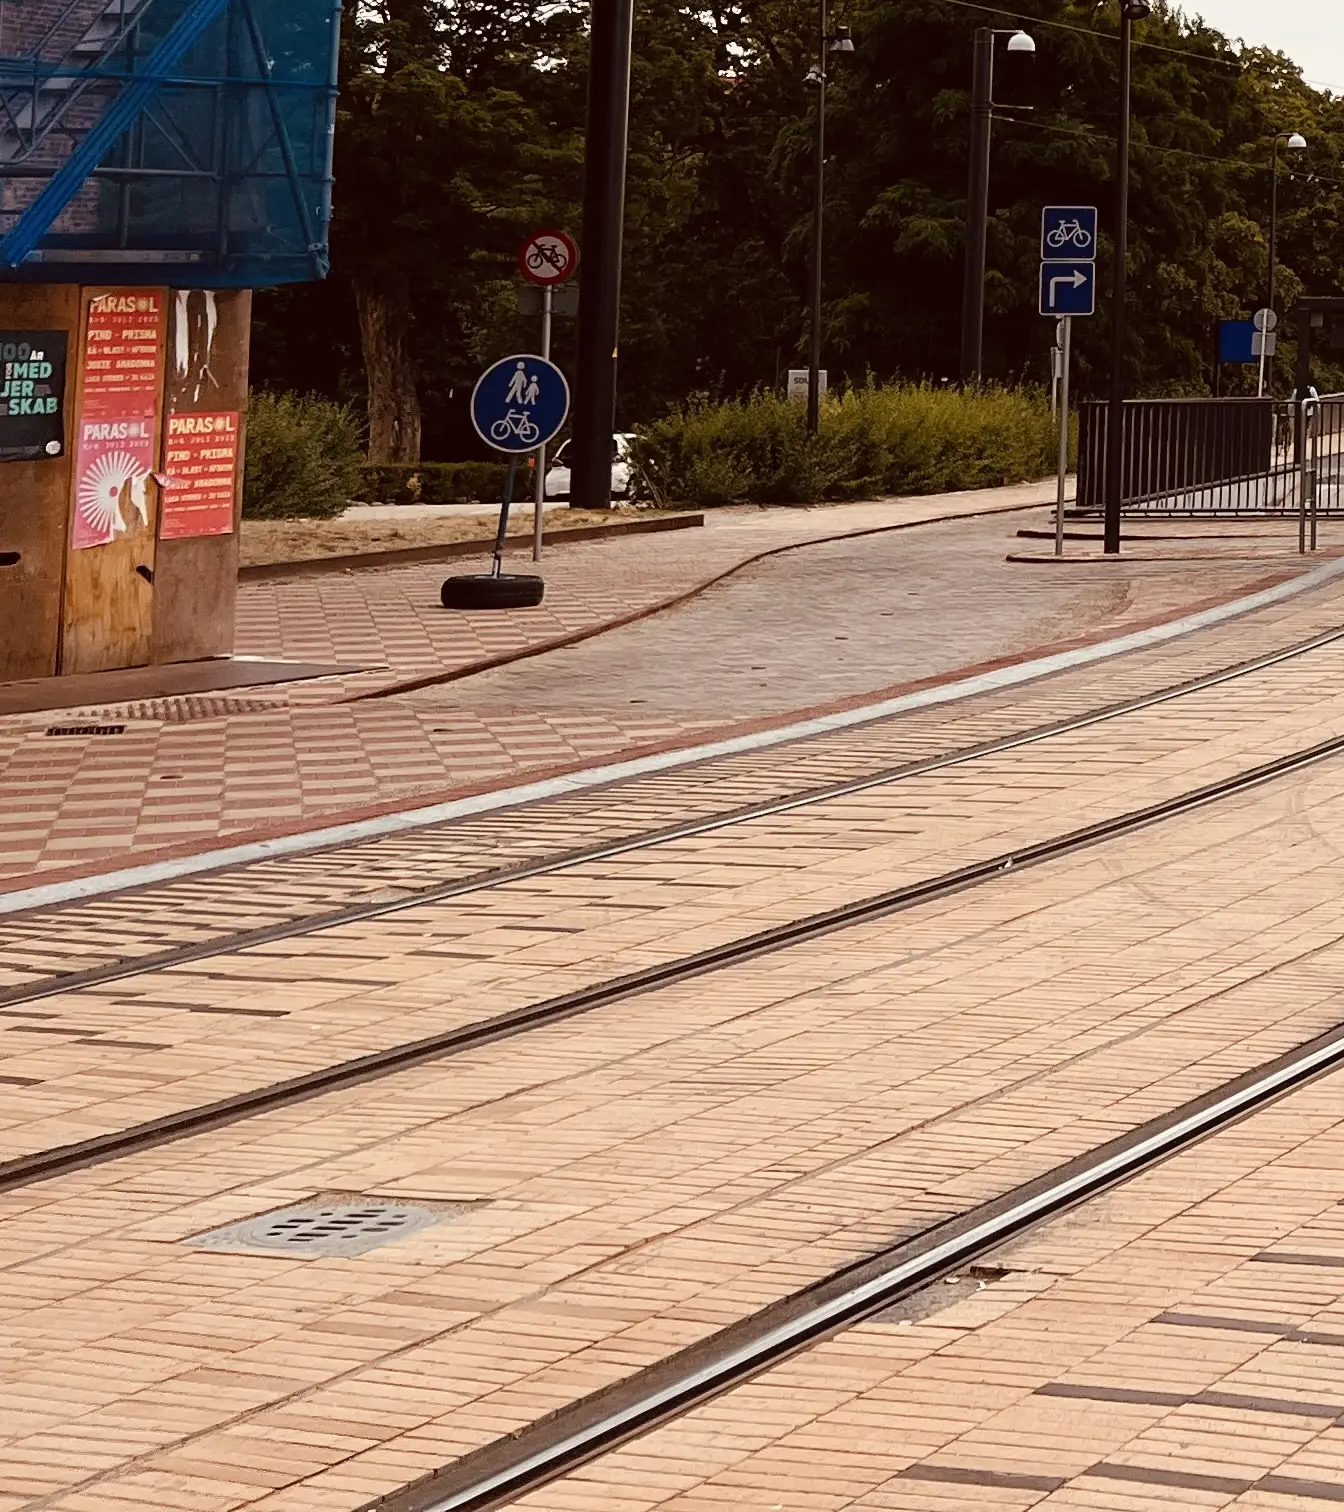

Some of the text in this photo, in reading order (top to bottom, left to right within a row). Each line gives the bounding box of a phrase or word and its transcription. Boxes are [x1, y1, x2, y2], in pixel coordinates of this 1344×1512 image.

[13, 361, 52, 379] MED
[8, 396, 58, 415] SKAB
[83, 422, 150, 441] PARASOL
[169, 416, 235, 435] PARASOL
